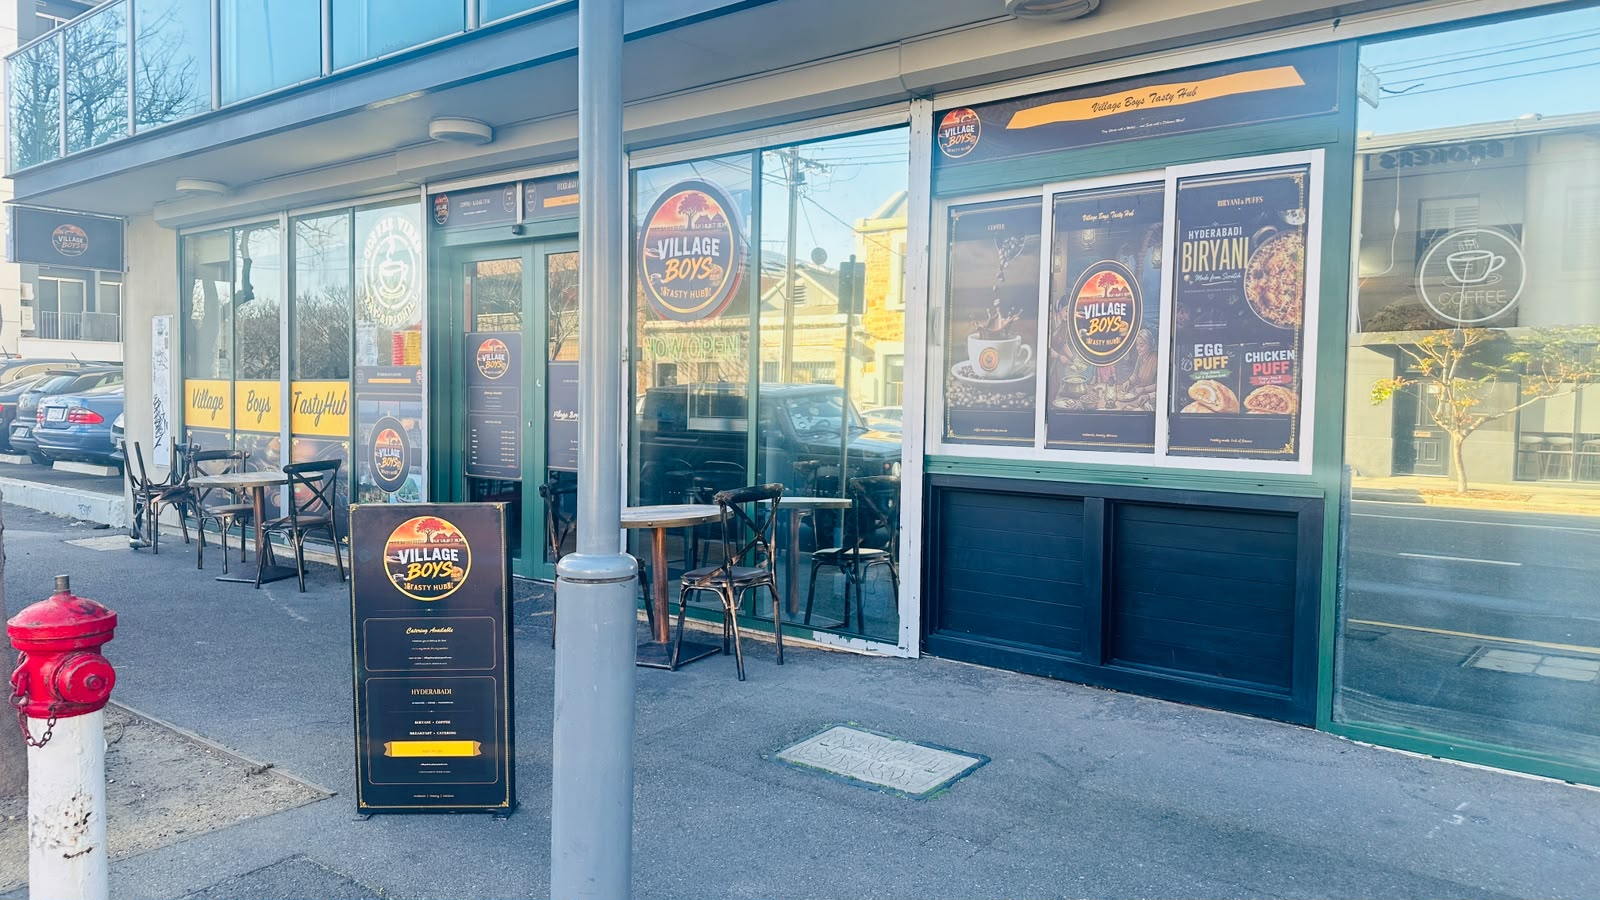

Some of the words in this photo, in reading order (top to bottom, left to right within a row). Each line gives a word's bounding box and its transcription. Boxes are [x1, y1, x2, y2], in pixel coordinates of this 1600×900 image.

[1091, 101, 1121, 112] Village
[1124, 96, 1145, 107] Boys
[1149, 92, 1174, 103] Tasty
[1176, 86, 1199, 98] Hub
[945, 125, 975, 138] VILLAGE
[947, 133, 972, 147] BOYS
[1217, 198, 1240, 207] BIRYANI
[1245, 196, 1263, 204] PUFFS
[1082, 214, 1098, 222] Village
[1098, 212, 1109, 220] Boys
[58, 235, 83, 243] VILLAGE
[1188, 226, 1242, 240] HYDERABADI
[657, 236, 720, 260] VILLAGE
[1182, 237, 1249, 273] BIRYANI
[661, 256, 713, 284] BOYS
[1195, 273, 1209, 281] Made
[665, 287, 688, 299] TASTY
[689, 288, 707, 299] HUB
[1438, 290, 1507, 305] COFFEE
[1084, 302, 1127, 320] VILLAGE
[1087, 315, 1122, 336] BOYS
[644, 335, 684, 361] NOW
[687, 335, 740, 360] OPEN
[1194, 343, 1223, 357] EGG
[482, 353, 505, 362] VILLAGE
[1193, 355, 1229, 371] PUFF
[1245, 350, 1295, 363] CHICKEN
[485, 360, 503, 369] BOYS
[1252, 361, 1290, 375] PUFF
[192, 388, 224, 421] Village
[246, 390, 271, 424] Boys
[379, 448, 401, 458] VILLAGE
[381, 457, 399, 467] BOYS
[398, 547, 459, 564] VILLAGE
[404, 561, 453, 581] BOYS
[409, 582, 431, 591] TASTY
[433, 582, 449, 591] HUB
[429, 626, 454, 634] Available
